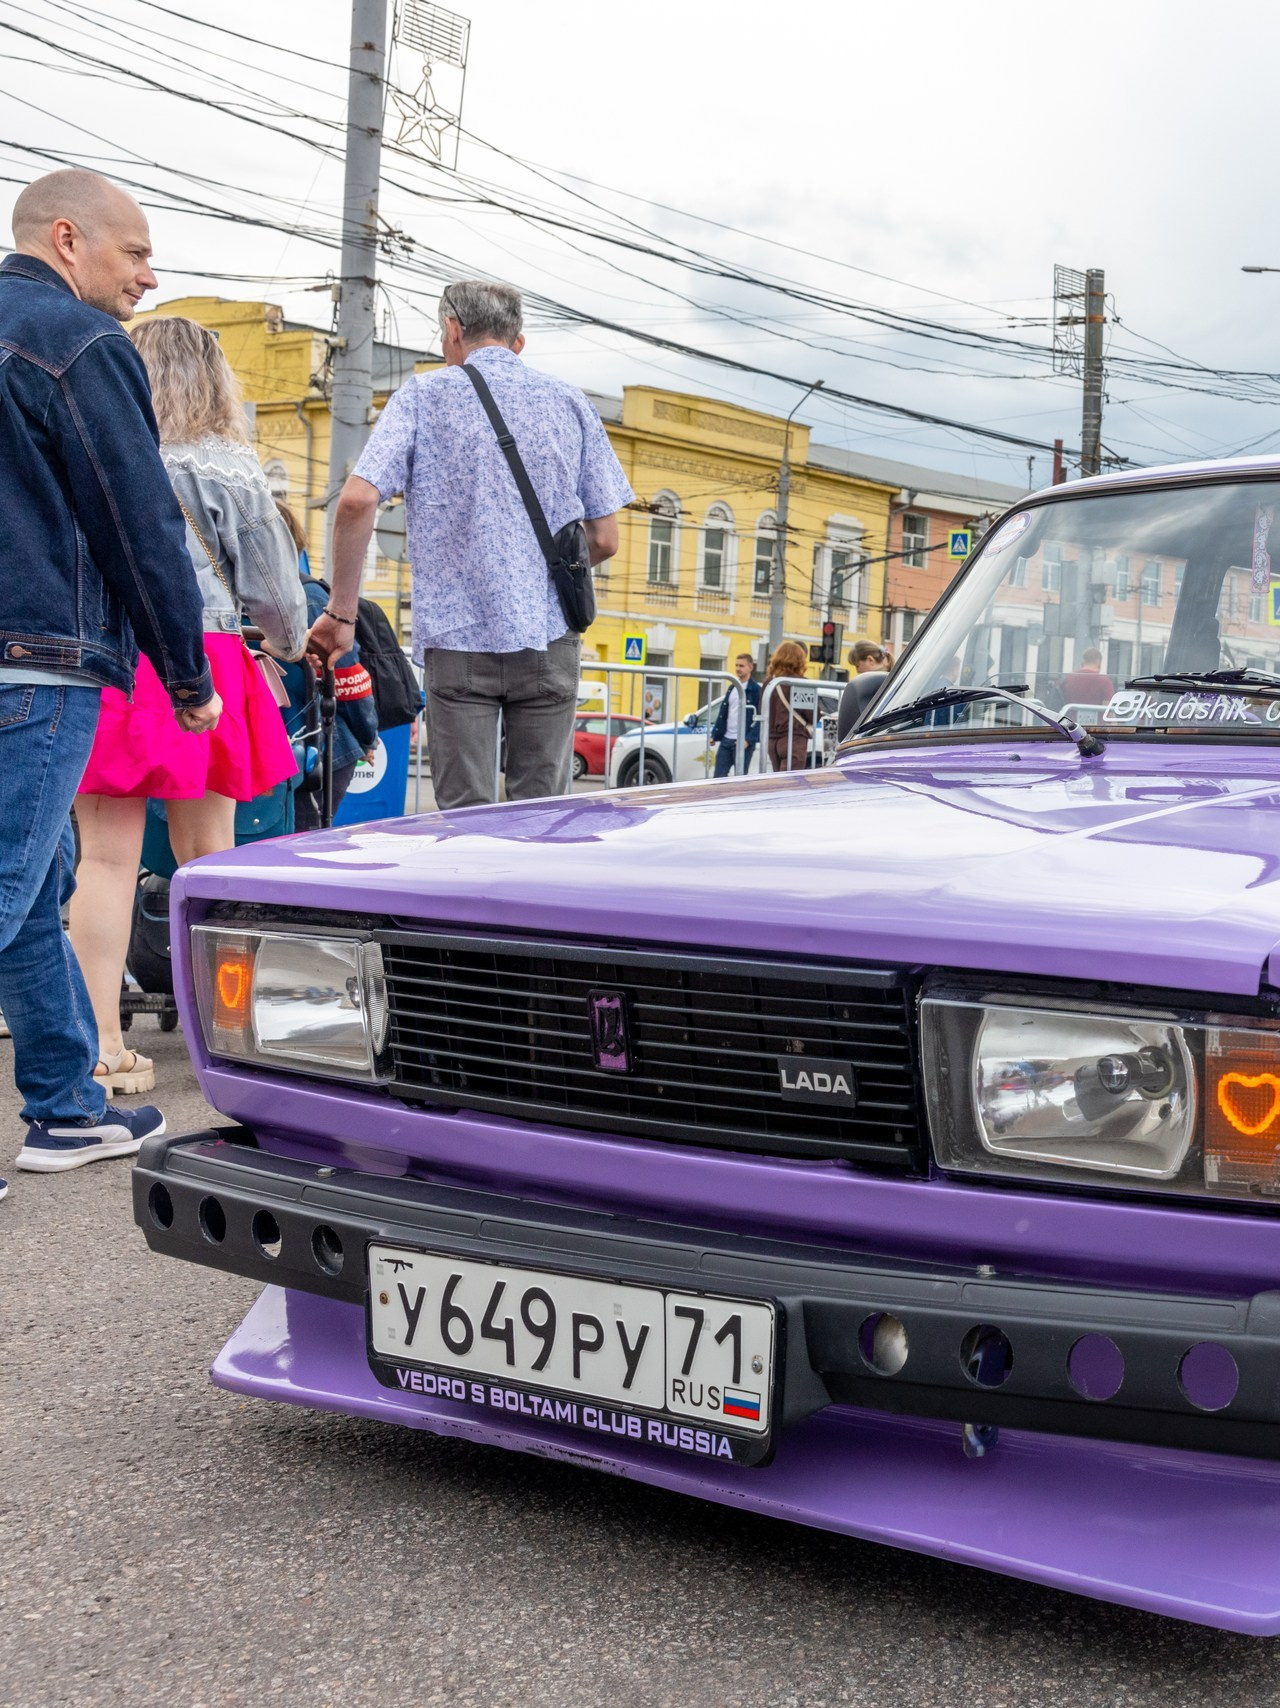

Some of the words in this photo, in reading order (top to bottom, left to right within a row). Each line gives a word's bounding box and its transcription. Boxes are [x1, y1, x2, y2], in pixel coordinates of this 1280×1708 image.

[780, 1069, 851, 1095] LADA
[674, 1304, 742, 1385] 71
[396, 1368, 466, 1400] VEDRO
[471, 1383, 485, 1404] S
[490, 1387, 577, 1424] BOLTAMI
[583, 1407, 642, 1439] CLUB
[647, 1420, 733, 1460] RUSSIA
[672, 1378, 721, 1411] RUS
